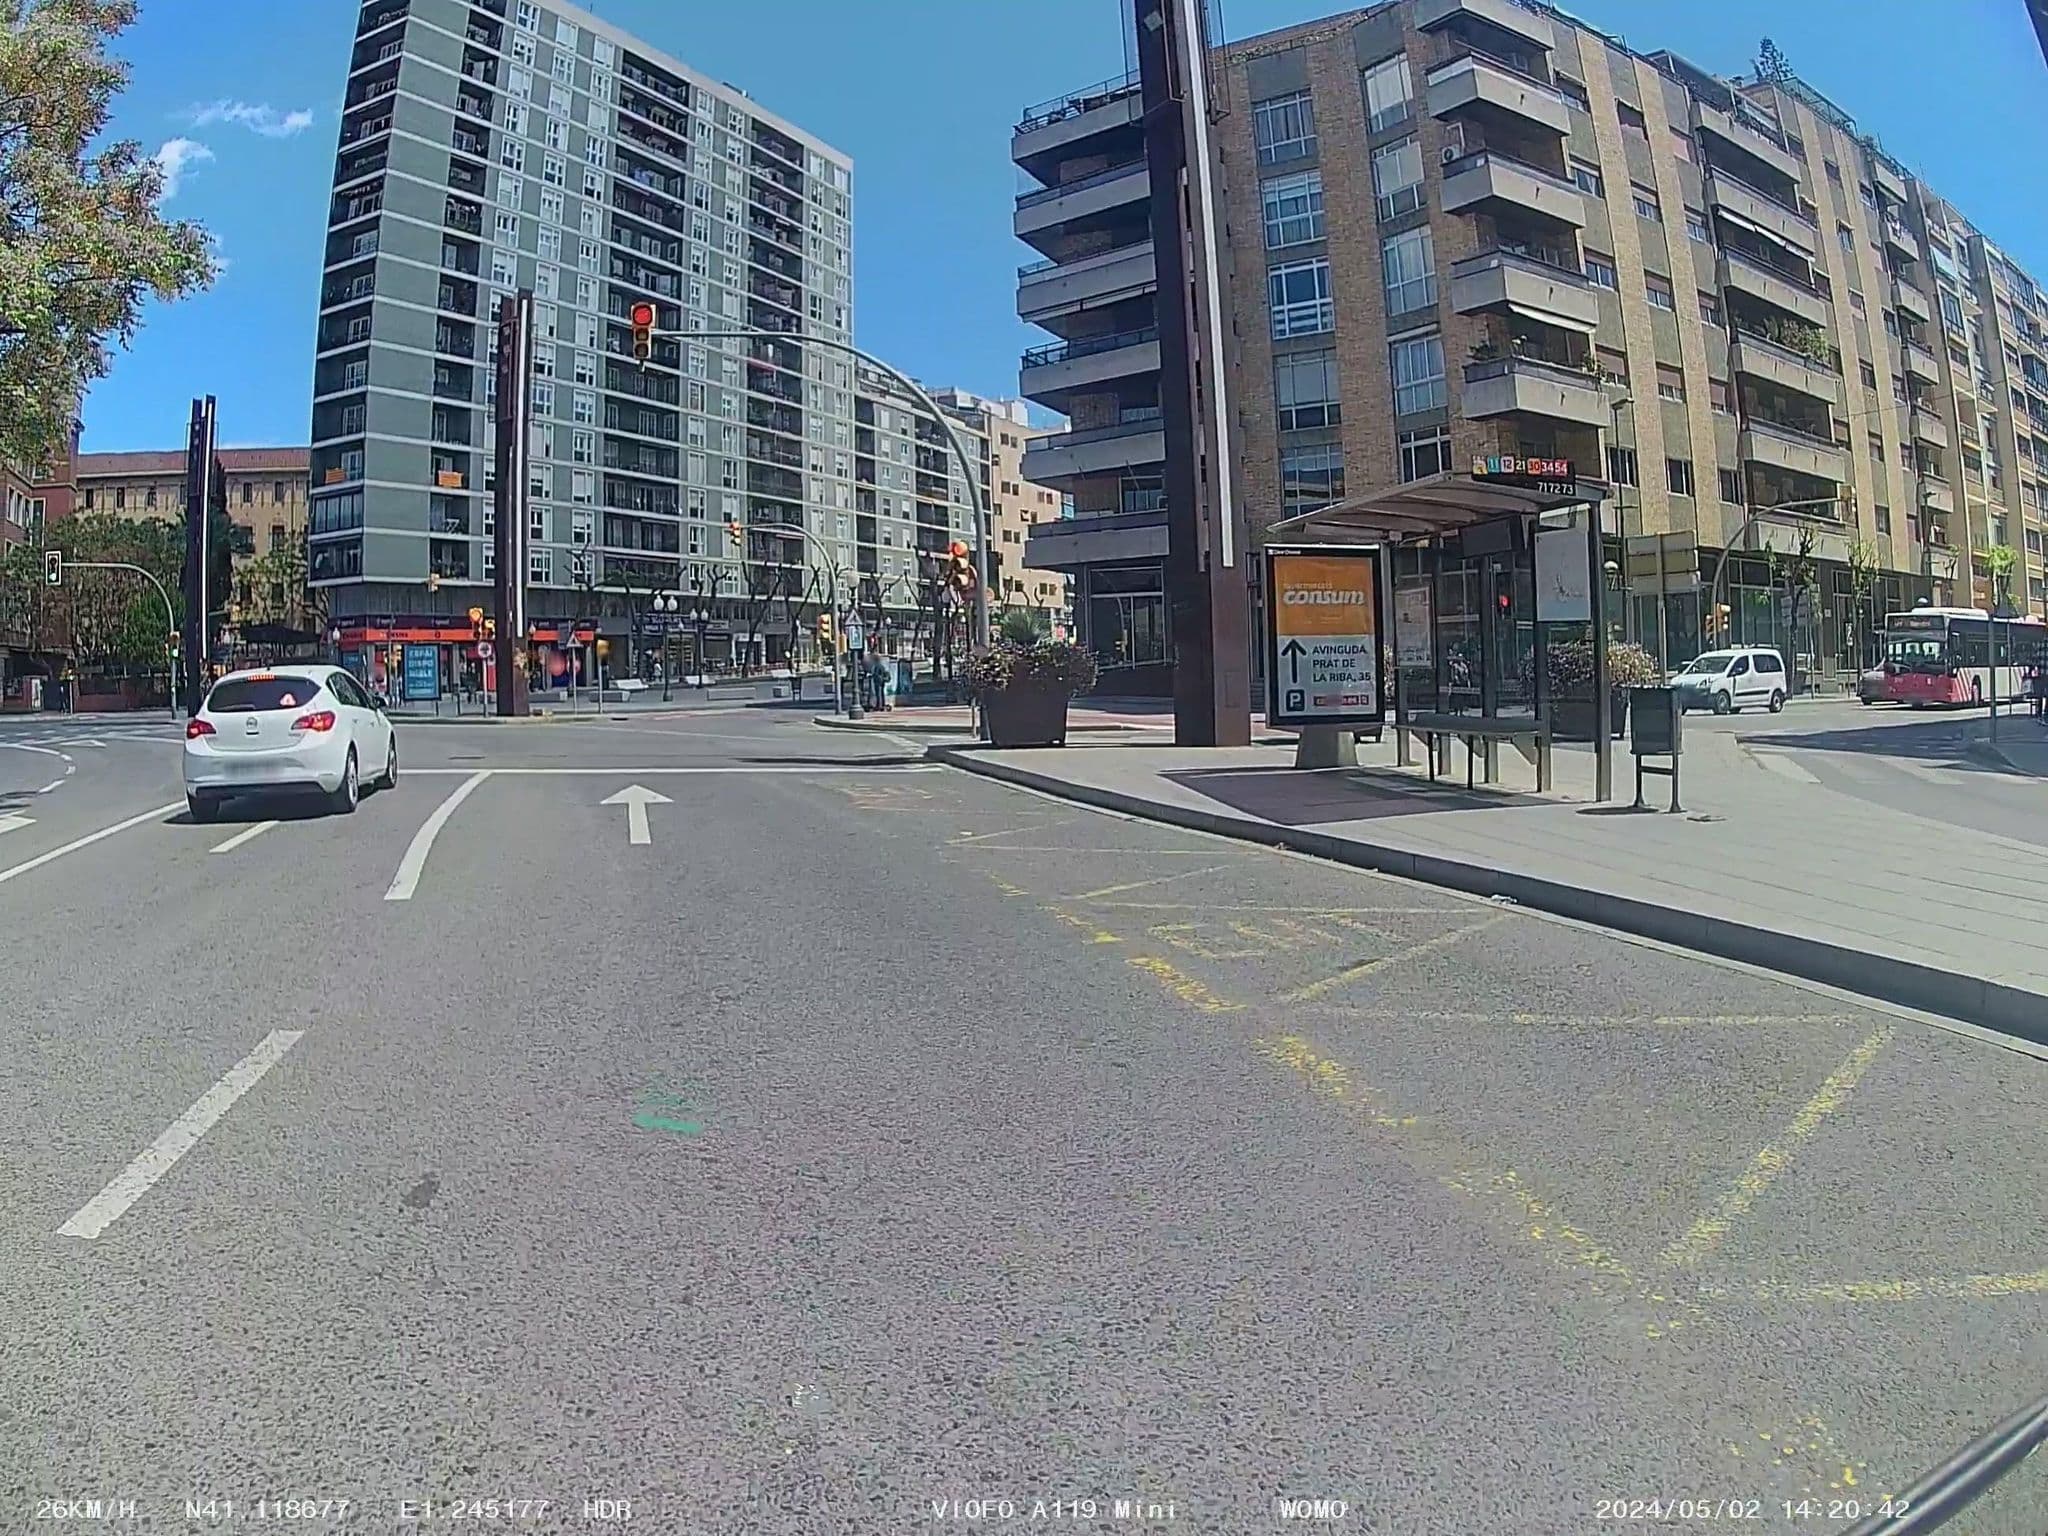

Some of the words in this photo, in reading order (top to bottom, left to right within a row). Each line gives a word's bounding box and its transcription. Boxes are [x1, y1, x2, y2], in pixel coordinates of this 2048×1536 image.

[1502, 459, 1513, 469] 12
[1515, 460, 1526, 471] 21
[1529, 460, 1540, 470] 30
[1541, 461, 1554, 472] 34
[1554, 462, 1568, 474] 54
[1537, 481, 1548, 493] 71
[1548, 482, 1561, 494] 72
[1561, 483, 1574, 495] 73
[1284, 590, 1365, 605] consum
[1312, 645, 1367, 654] AVINGUDA
[1312, 659, 1339, 668] PRAT
[1342, 658, 1356, 668] DE
[1312, 673, 1327, 682] LA
[1329, 672, 1356, 682] RIBA,
